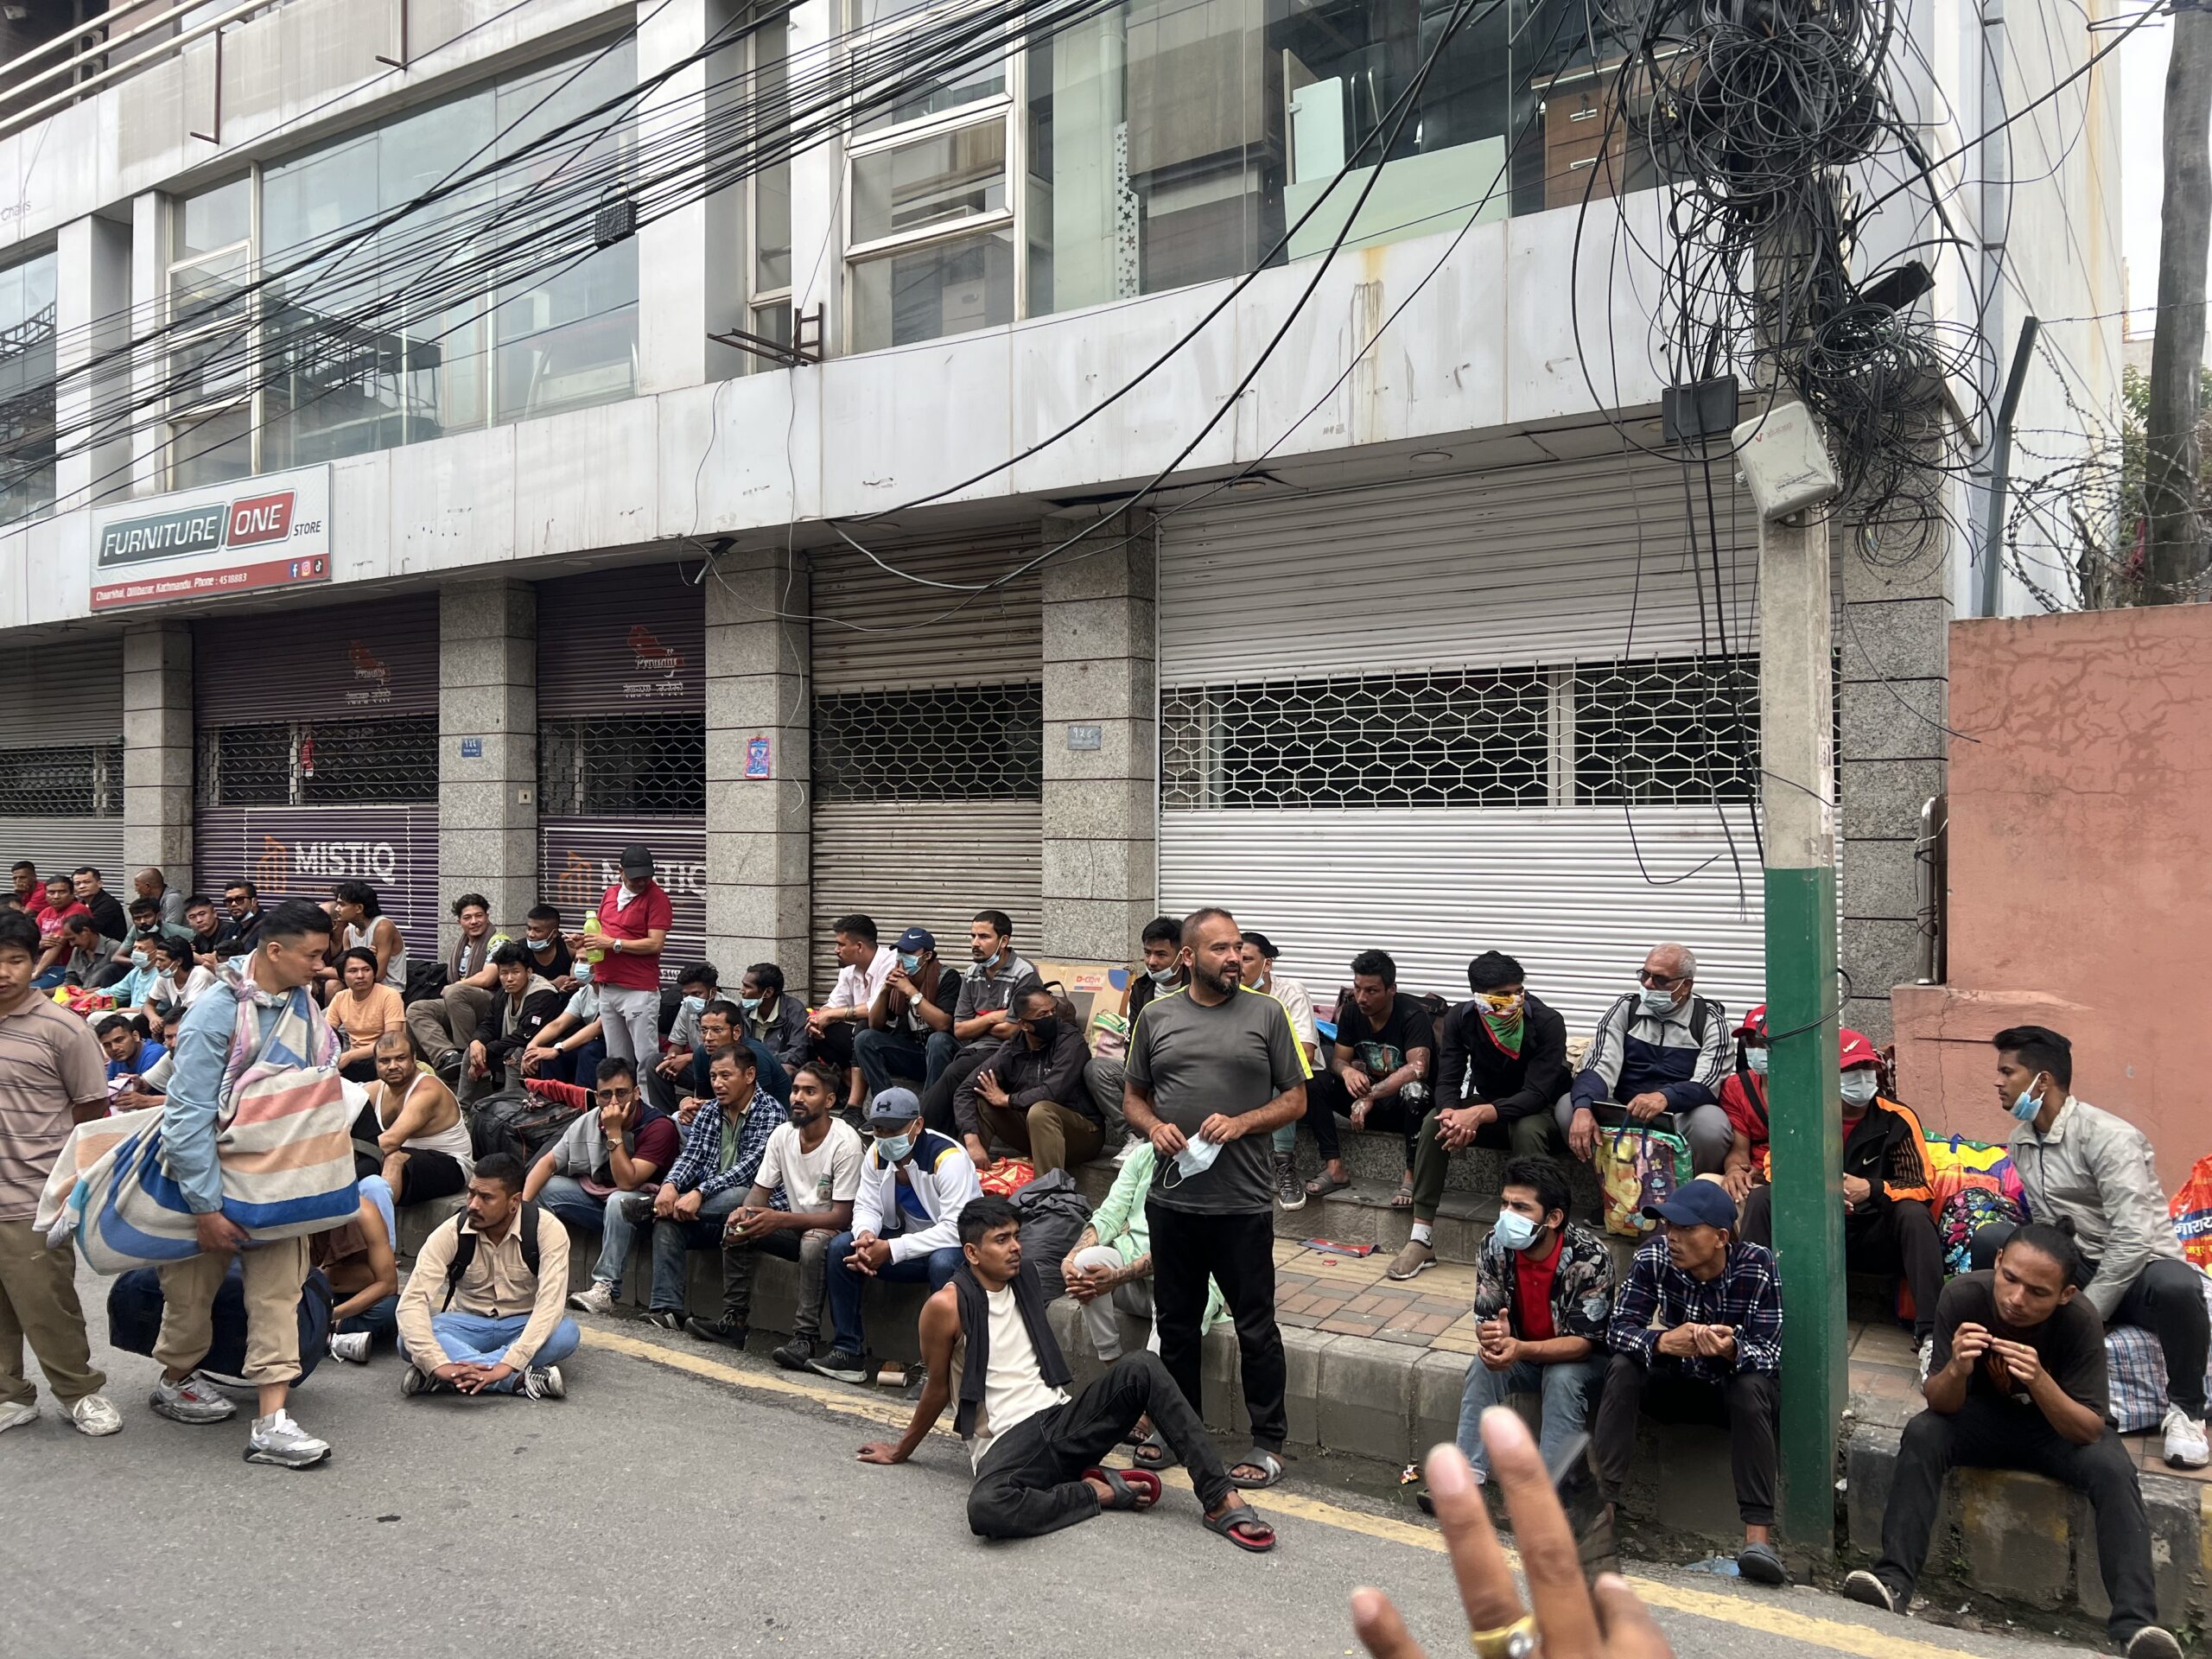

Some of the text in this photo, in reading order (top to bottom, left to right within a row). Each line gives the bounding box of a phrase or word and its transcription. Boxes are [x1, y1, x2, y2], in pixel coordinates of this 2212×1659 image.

[104, 504, 321, 557] FURNITURE ONE STORE
[295, 842, 396, 886] MISTIQ
